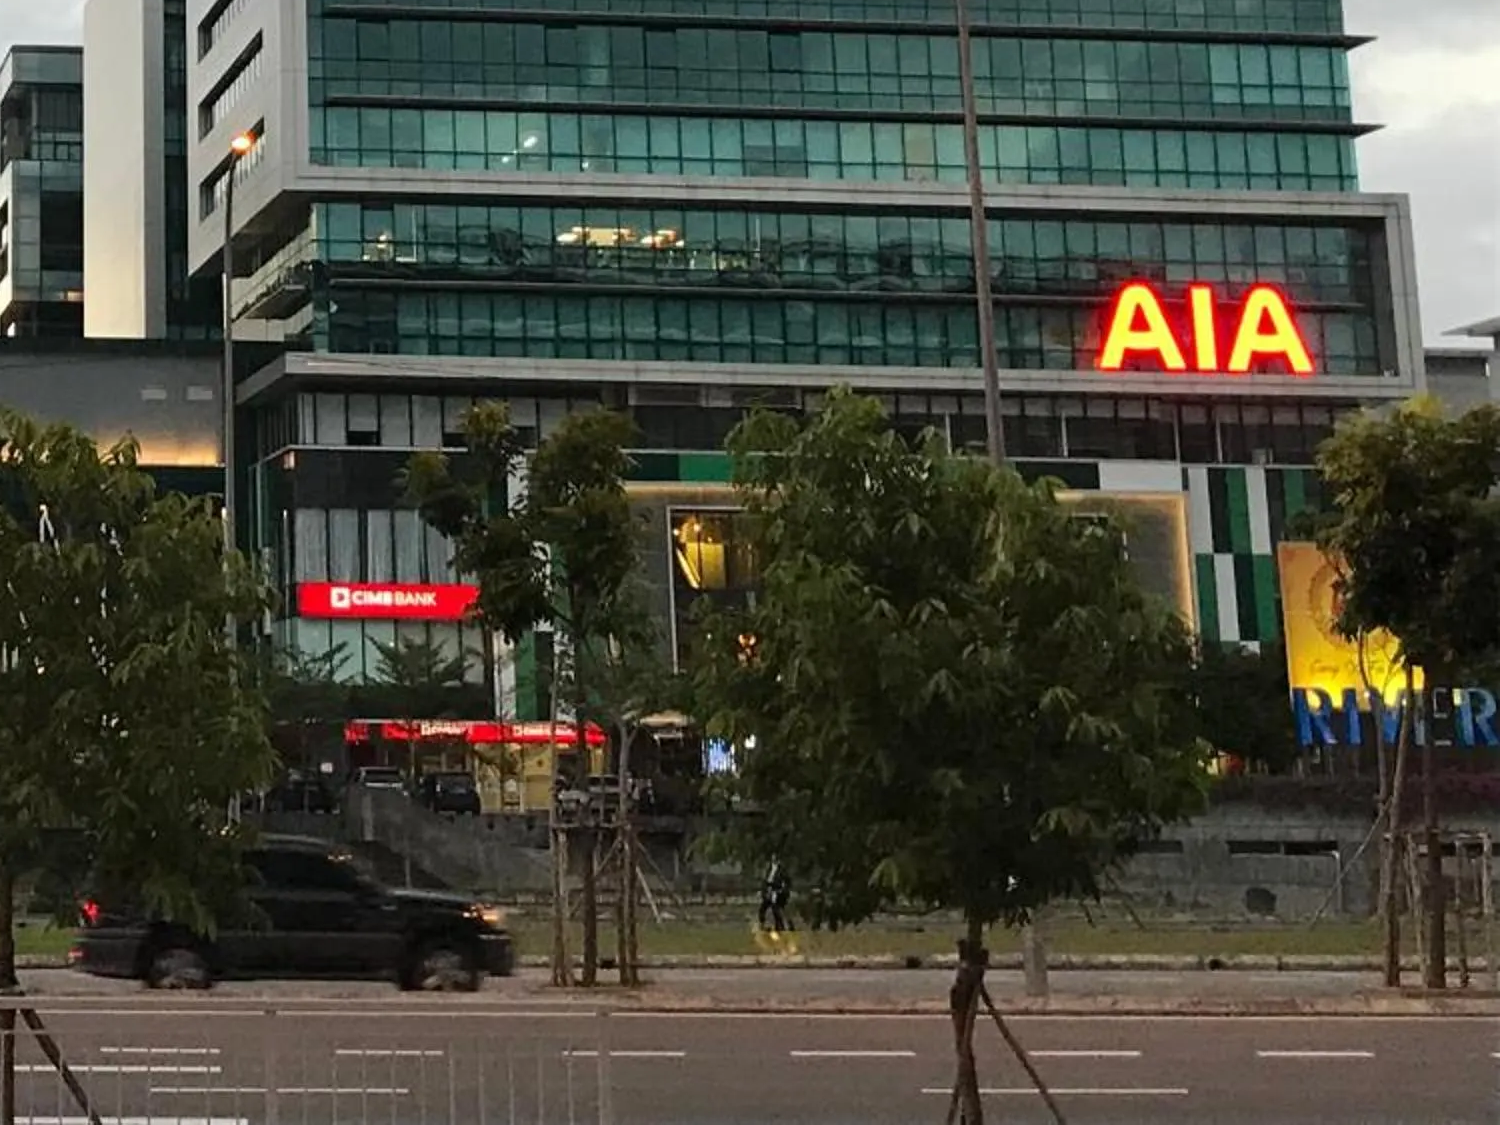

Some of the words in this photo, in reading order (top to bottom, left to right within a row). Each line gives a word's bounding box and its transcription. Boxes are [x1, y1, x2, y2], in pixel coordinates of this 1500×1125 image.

[1099, 284, 1314, 373] AIA
[351, 590, 392, 606] CIMB
[394, 591, 437, 607] BANK
